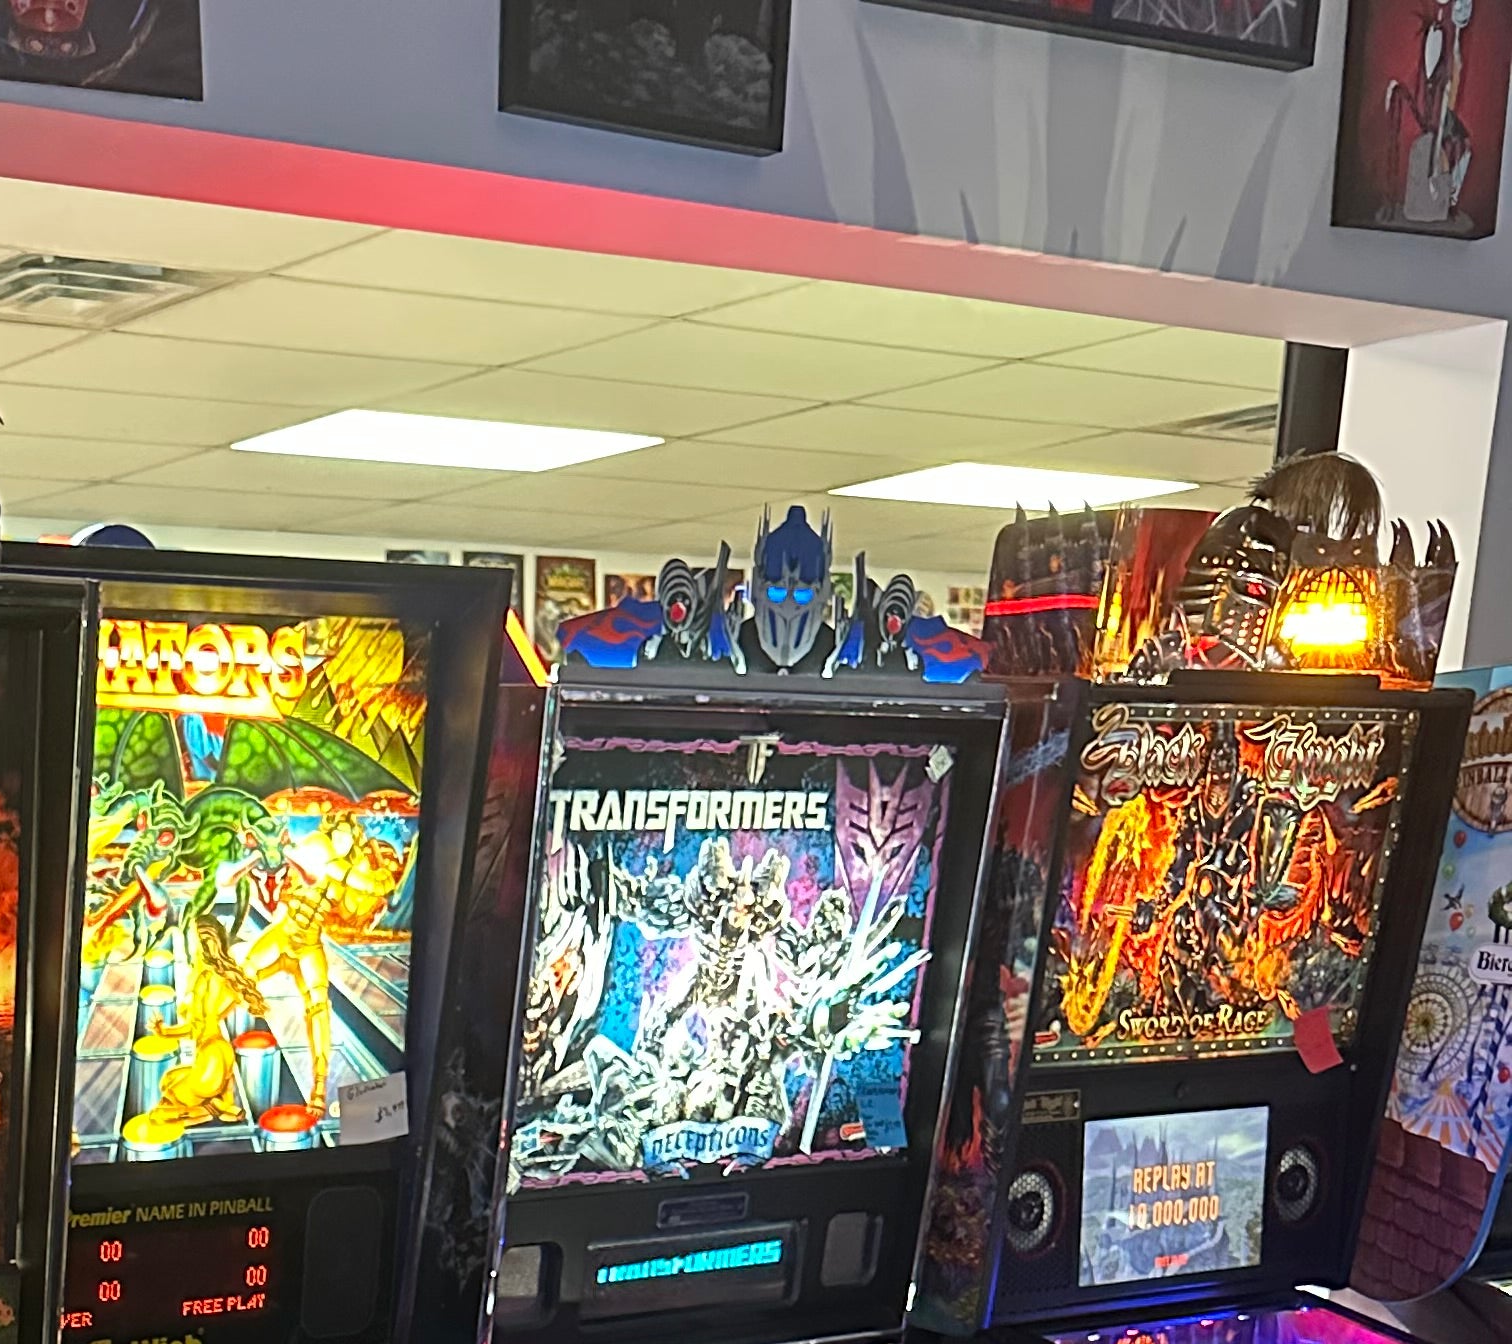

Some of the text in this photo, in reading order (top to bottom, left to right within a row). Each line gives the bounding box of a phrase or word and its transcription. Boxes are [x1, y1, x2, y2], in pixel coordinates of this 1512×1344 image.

[549, 790, 831, 853] TRANSFORMERS
[1118, 1004, 1268, 1040] SWORD OF RAGE
[1133, 1161, 1216, 1193] REPLAY AT
[135, 1203, 185, 1222] NAME
[189, 1202, 206, 1218] IN
[210, 1196, 274, 1217] PINBALL
[183, 1297, 224, 1317] FREE
[227, 1293, 267, 1312] PLAY
